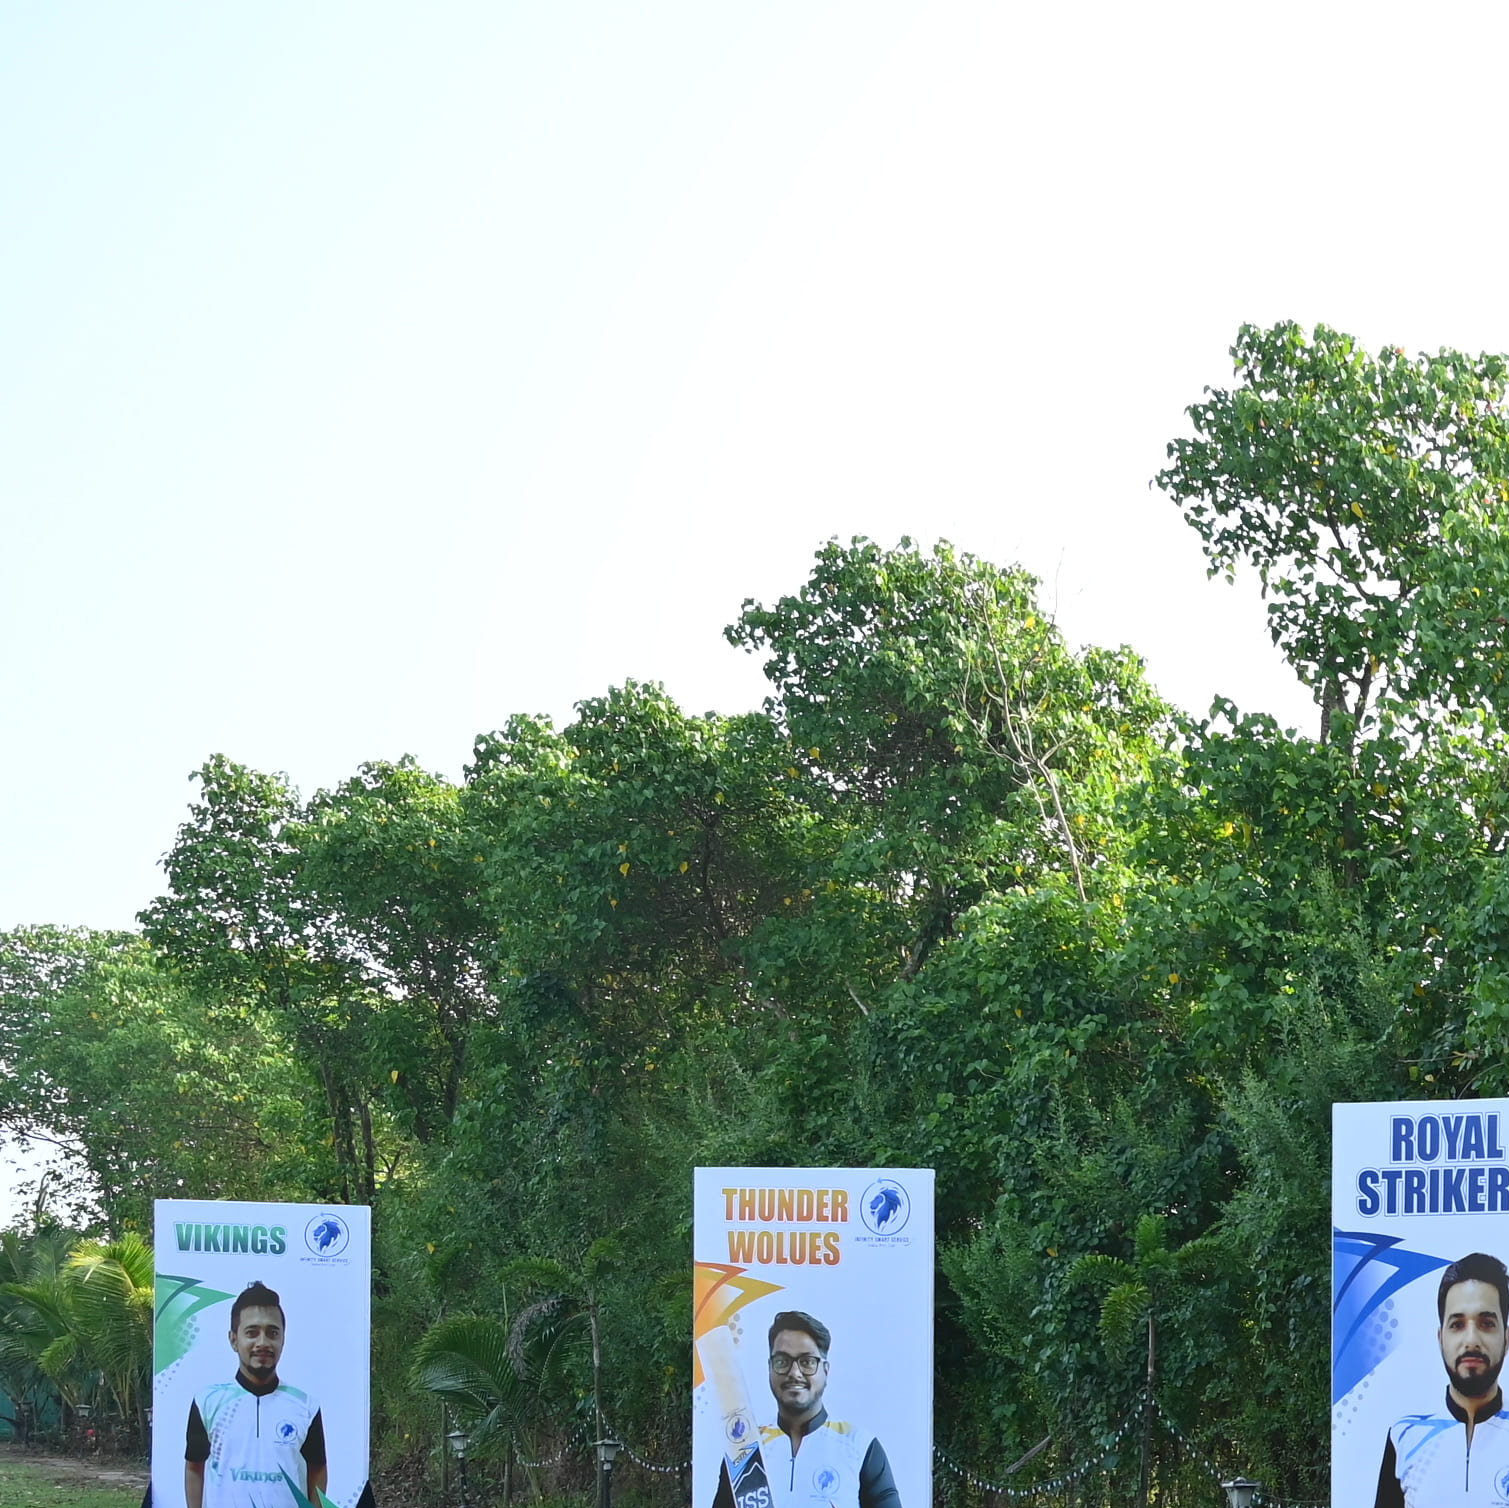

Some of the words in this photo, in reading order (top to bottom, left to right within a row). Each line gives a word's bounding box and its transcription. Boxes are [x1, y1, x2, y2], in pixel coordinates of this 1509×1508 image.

[1391, 1113, 1504, 1162] ROYAL
[721, 1187, 849, 1223] THUNDER
[174, 1222, 287, 1255] VIKINGS
